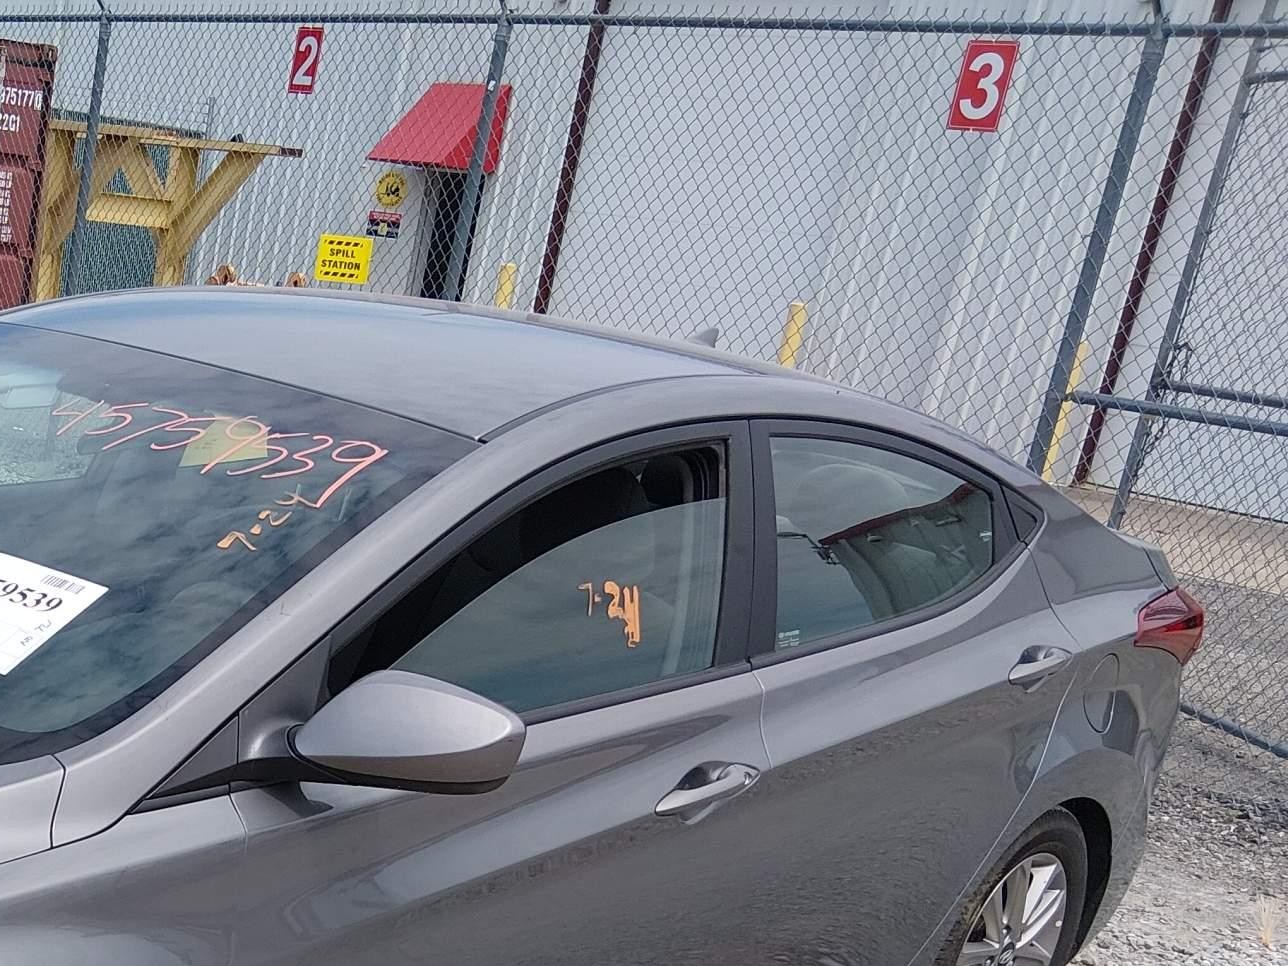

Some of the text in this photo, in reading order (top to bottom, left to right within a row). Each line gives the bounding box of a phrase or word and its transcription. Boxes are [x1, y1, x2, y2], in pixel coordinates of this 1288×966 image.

[292, 36, 318, 86] 2
[959, 52, 1005, 120] 3
[321, 259, 361, 271] STATION
[329, 248, 357, 259] SPILL
[51, 399, 390, 508] 45759539
